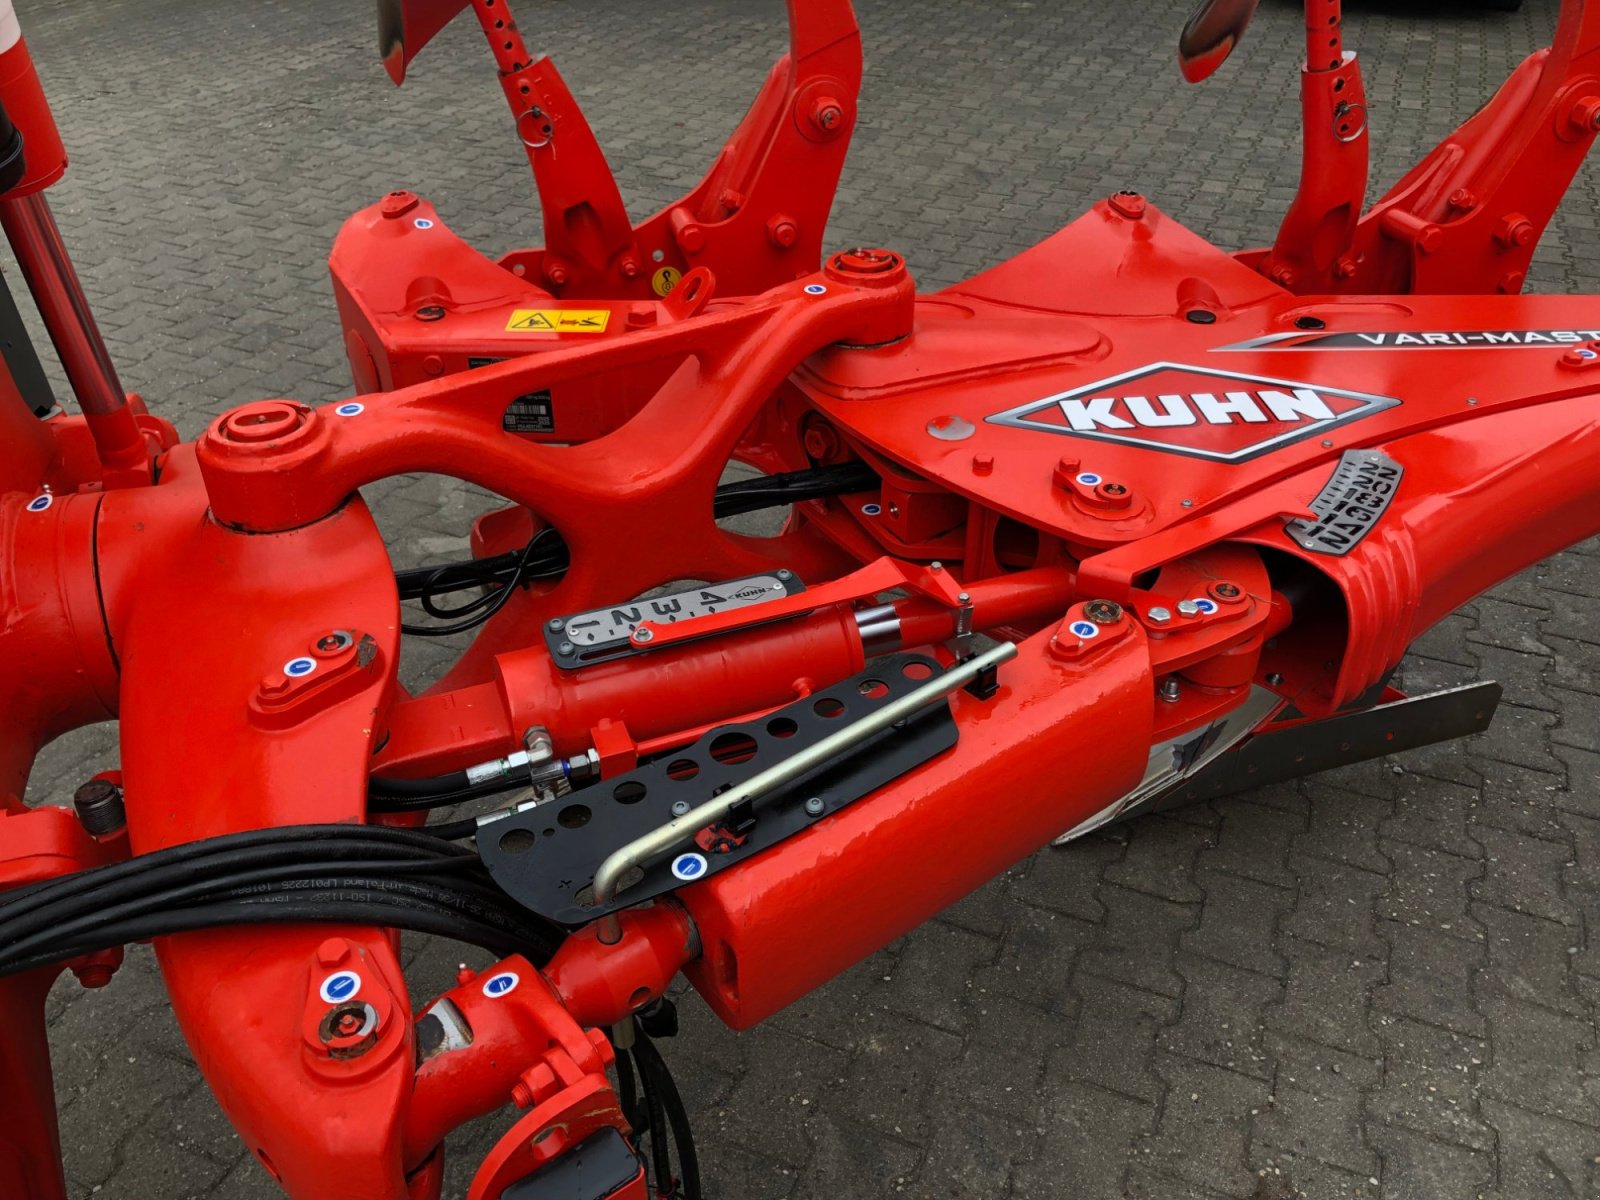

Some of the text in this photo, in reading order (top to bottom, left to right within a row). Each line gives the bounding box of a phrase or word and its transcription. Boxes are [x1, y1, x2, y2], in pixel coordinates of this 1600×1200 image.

[1057, 388, 1338, 431] KUHN
[734, 586, 767, 600] KUHN
[343, 878, 385, 890] Poland
